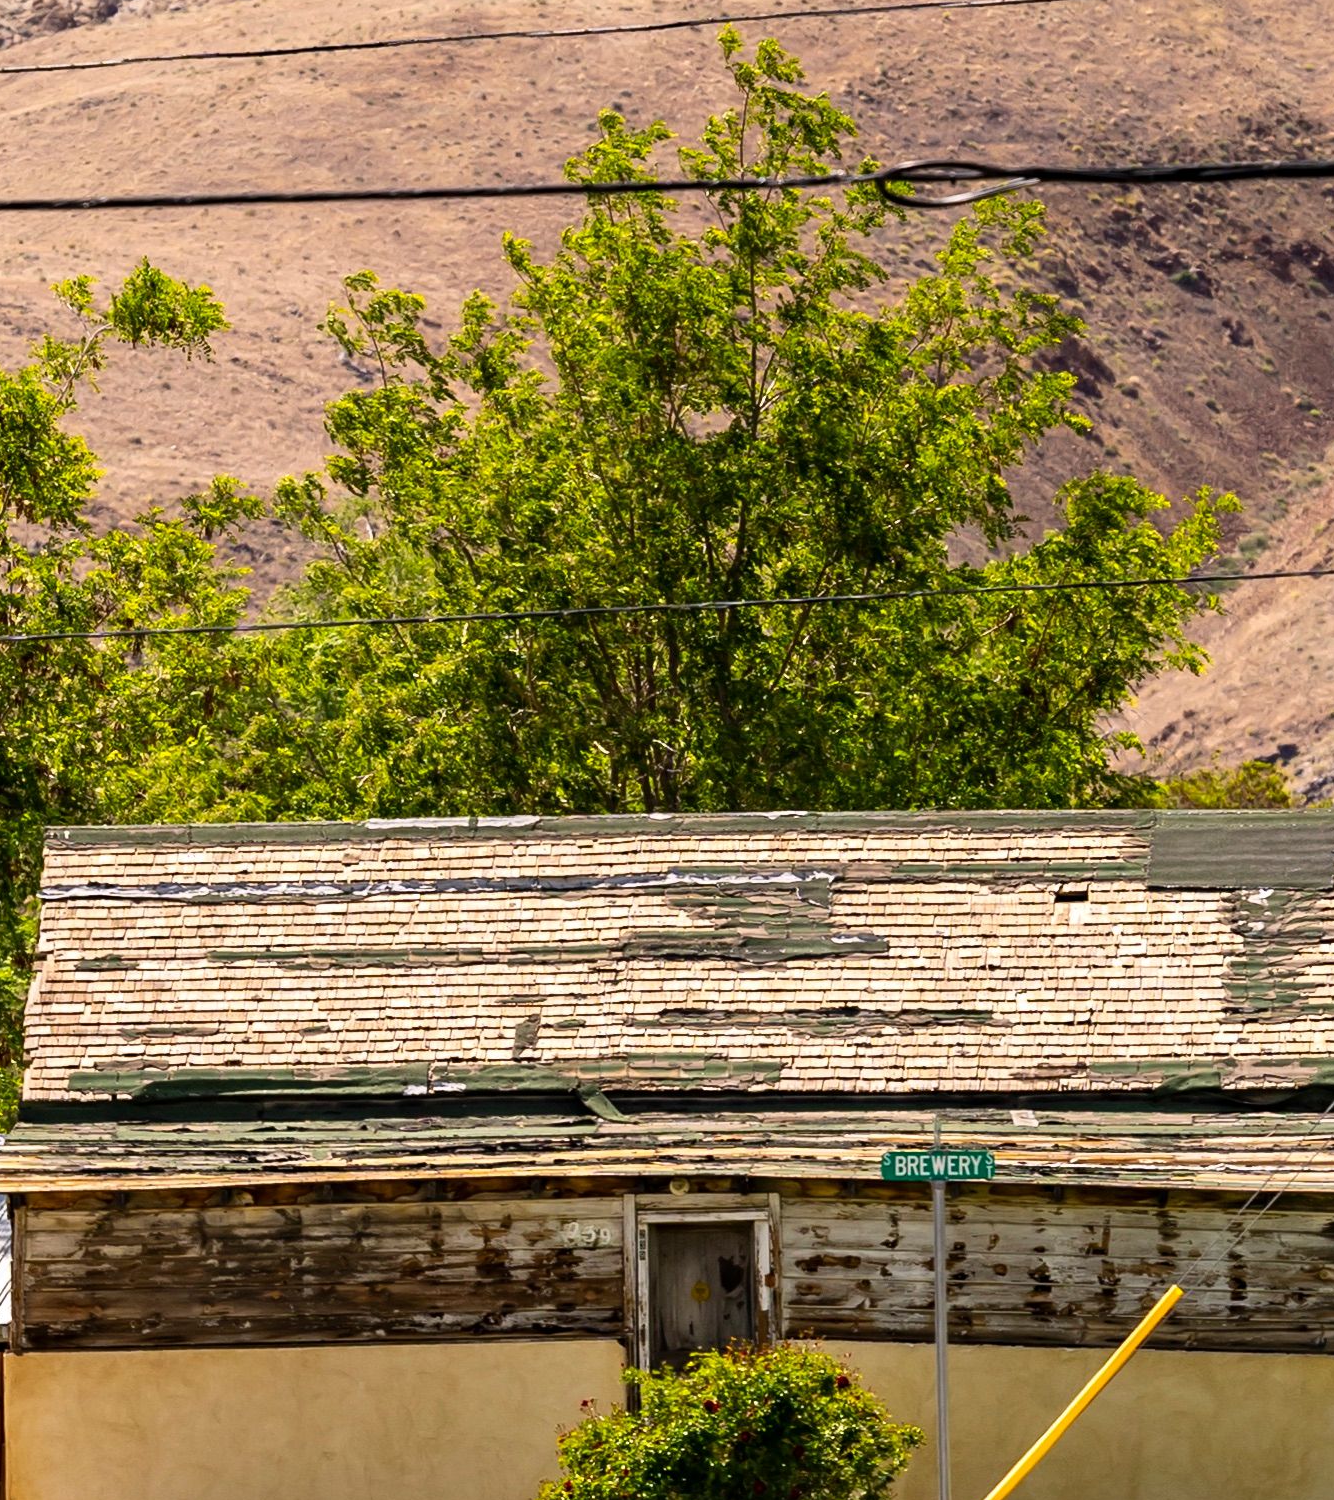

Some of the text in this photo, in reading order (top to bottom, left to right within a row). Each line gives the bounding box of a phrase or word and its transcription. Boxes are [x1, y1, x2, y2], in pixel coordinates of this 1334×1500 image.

[883, 1152, 993, 1179] S BREWERY ST
